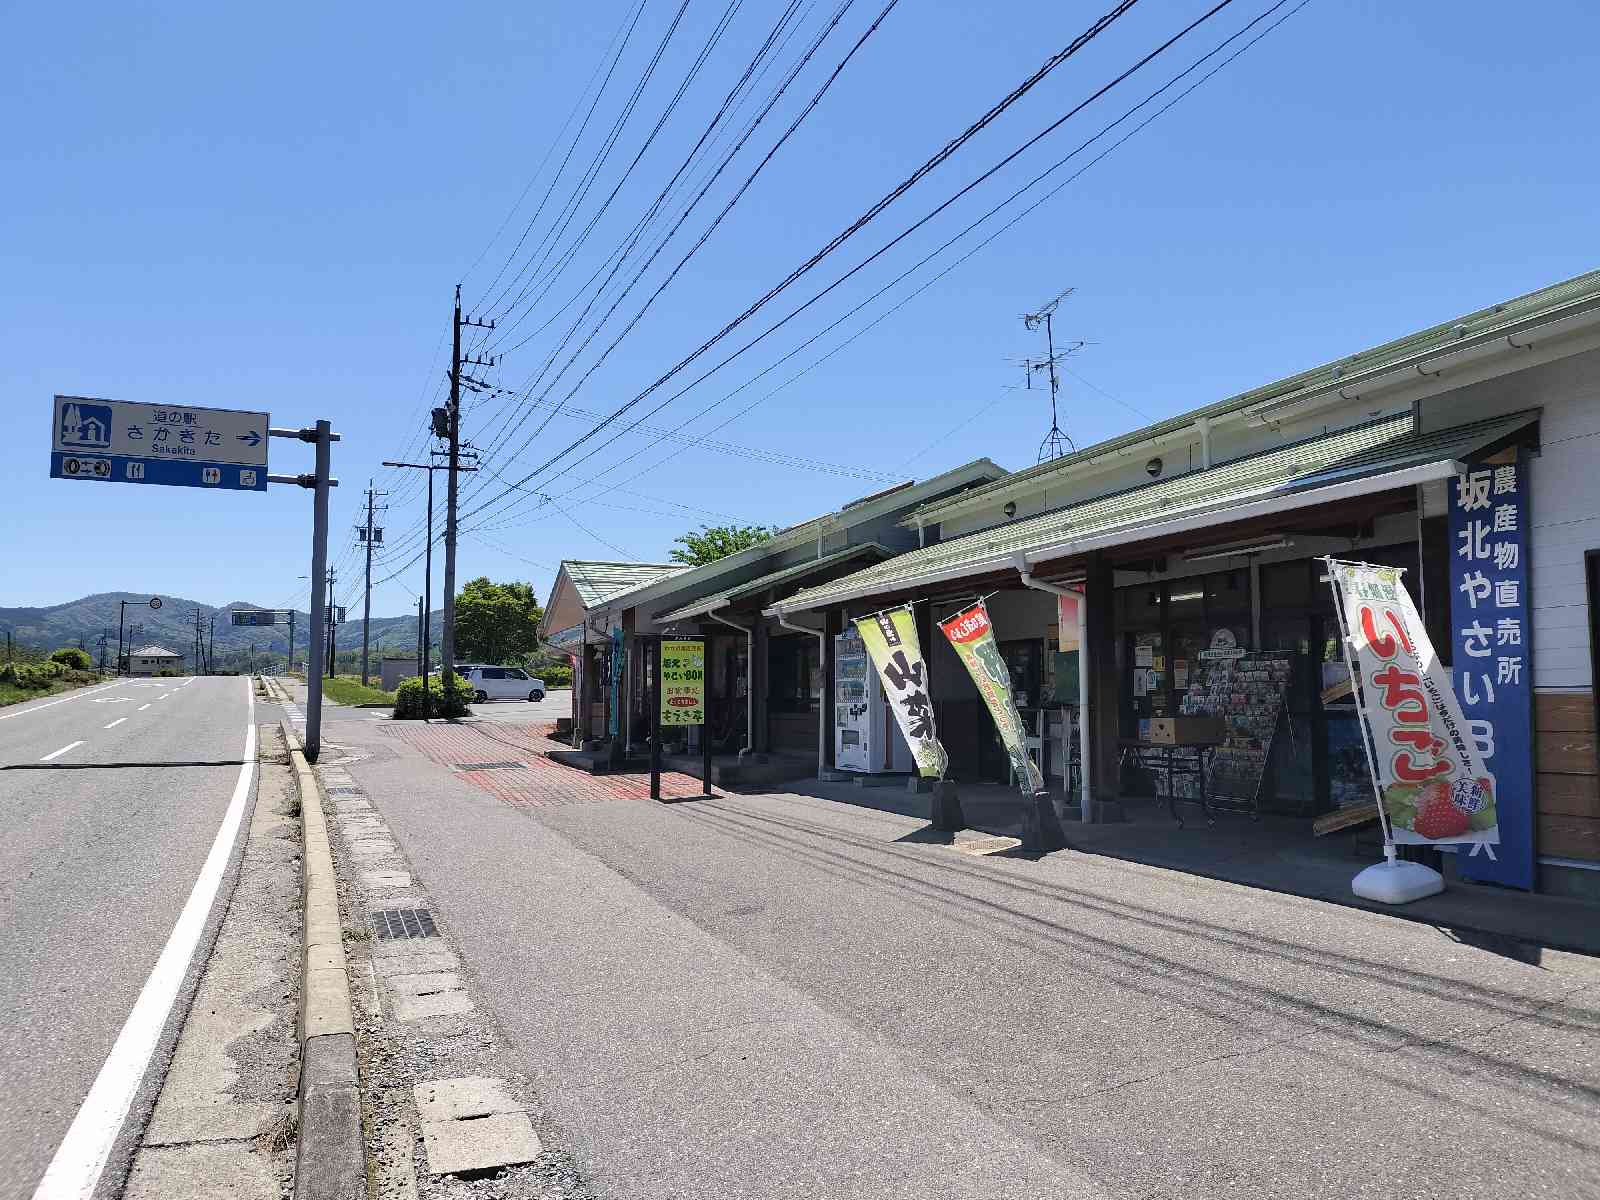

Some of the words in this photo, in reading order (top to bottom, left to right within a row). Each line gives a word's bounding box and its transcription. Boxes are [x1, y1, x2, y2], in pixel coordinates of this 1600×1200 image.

[128, 425, 221, 446] さかきた
[153, 409, 198, 425] 道の駅
[1493, 465, 1523, 686] 農産物直売所
[1360, 606, 1451, 783] いちご
[1456, 470, 1498, 862] 坂北やさいB
